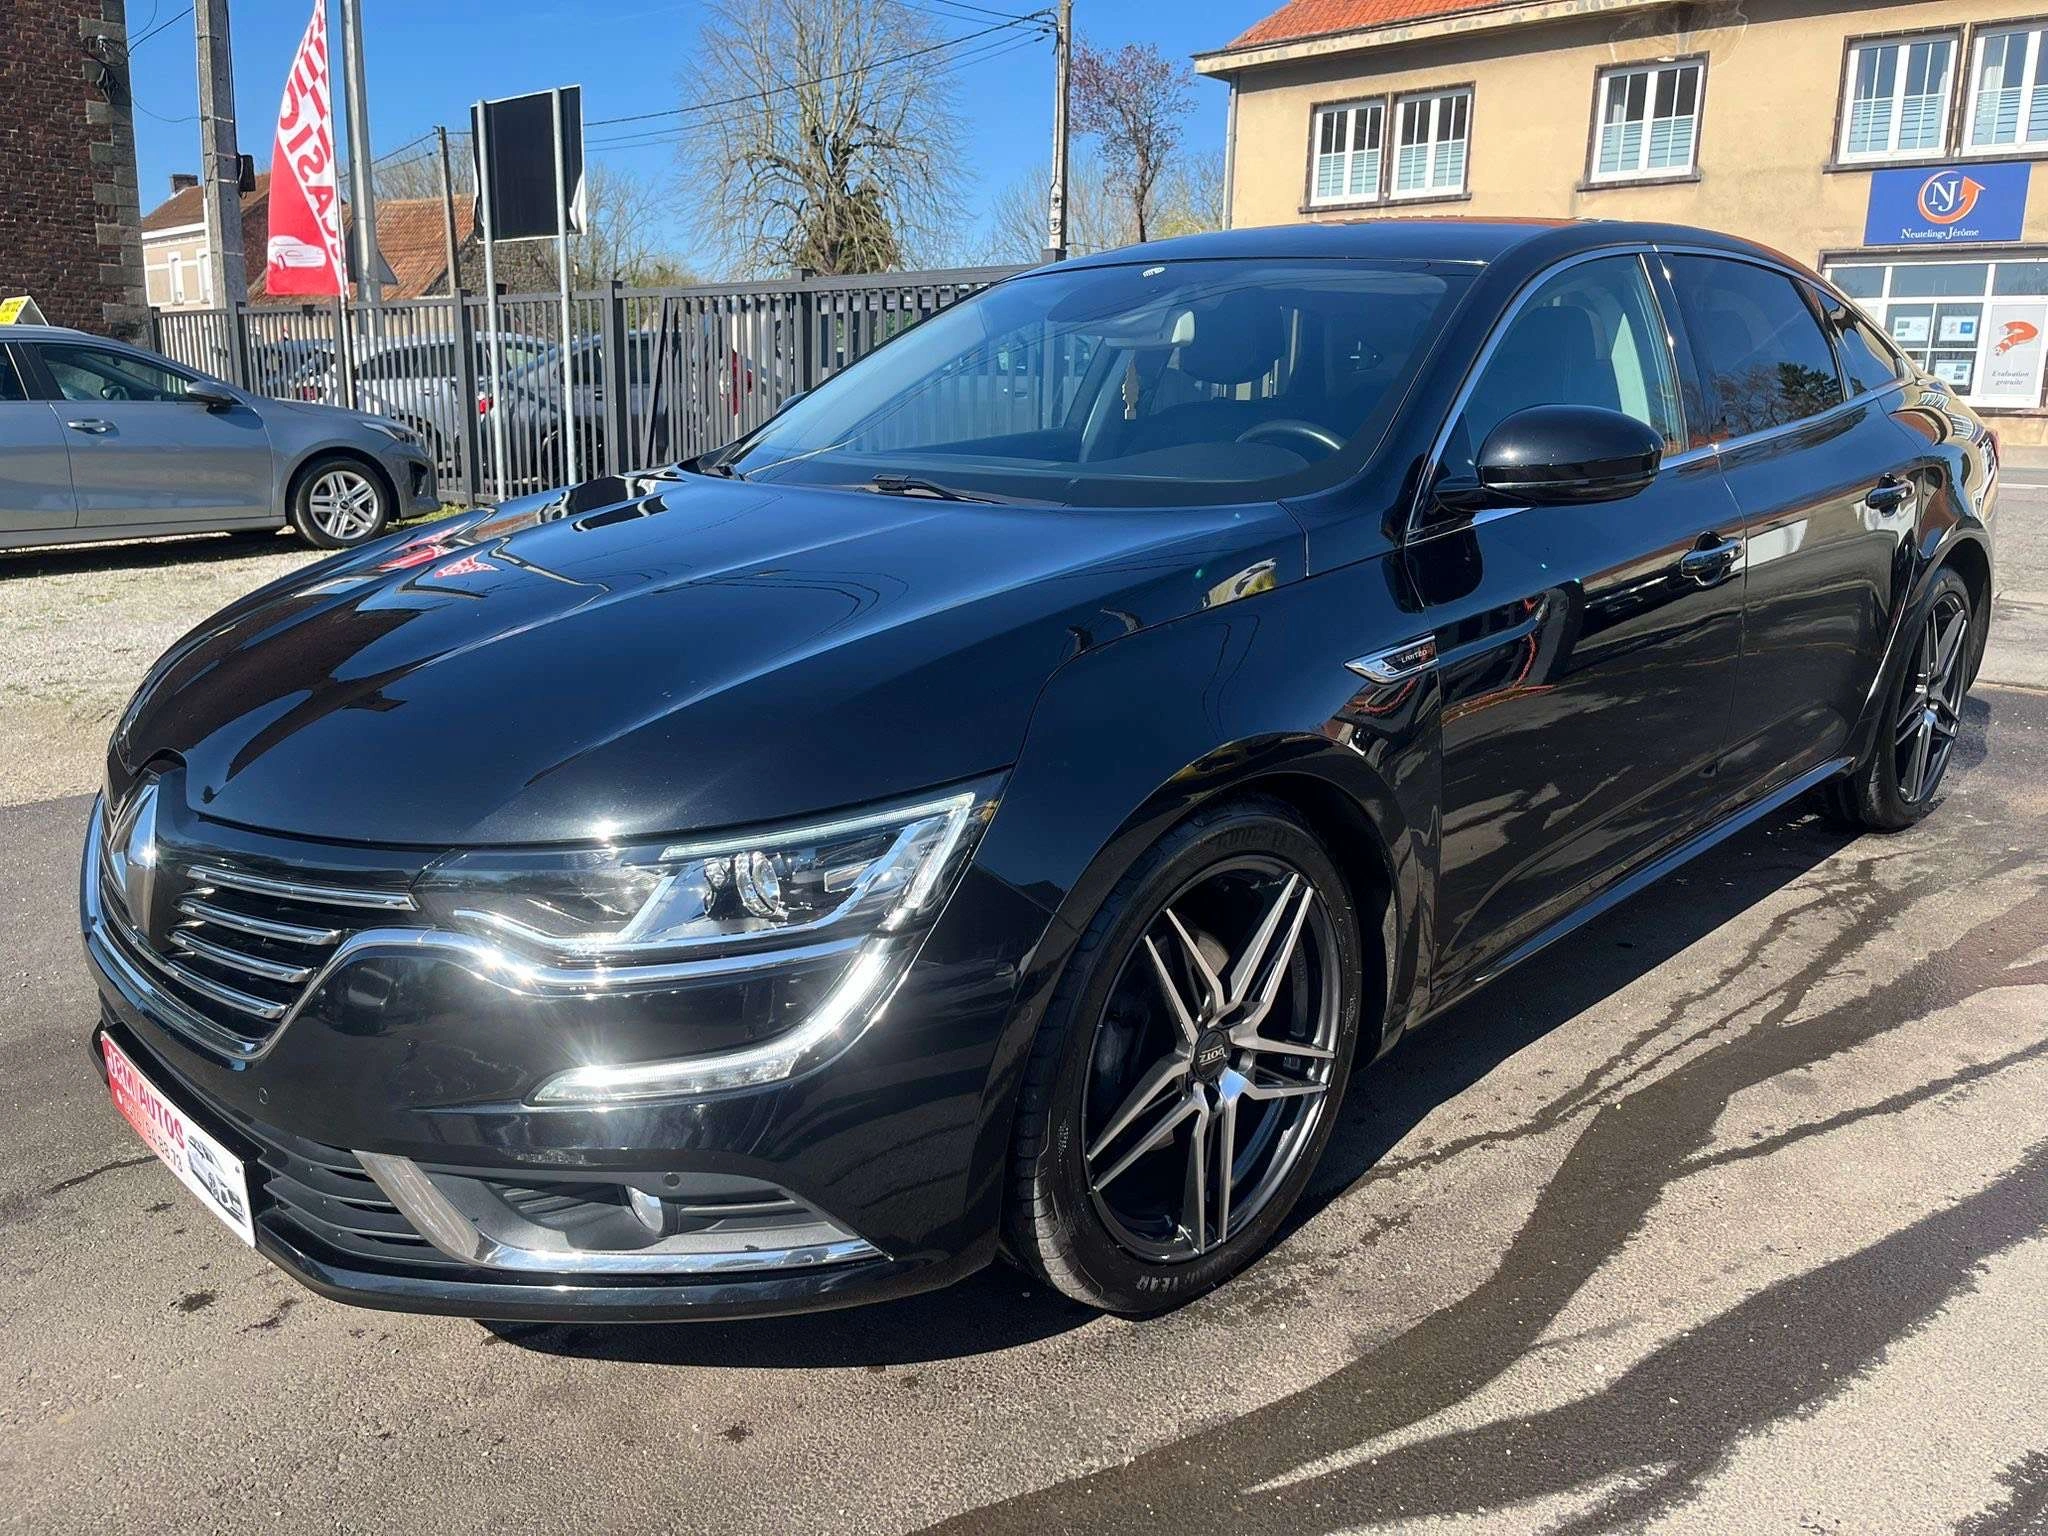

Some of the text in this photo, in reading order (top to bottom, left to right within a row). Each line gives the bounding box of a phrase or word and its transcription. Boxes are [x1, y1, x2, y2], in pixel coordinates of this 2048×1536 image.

[1929, 181, 1960, 212] NJ
[1945, 226, 1979, 240] Jérôme
[139, 1082, 185, 1150] AUTOS
